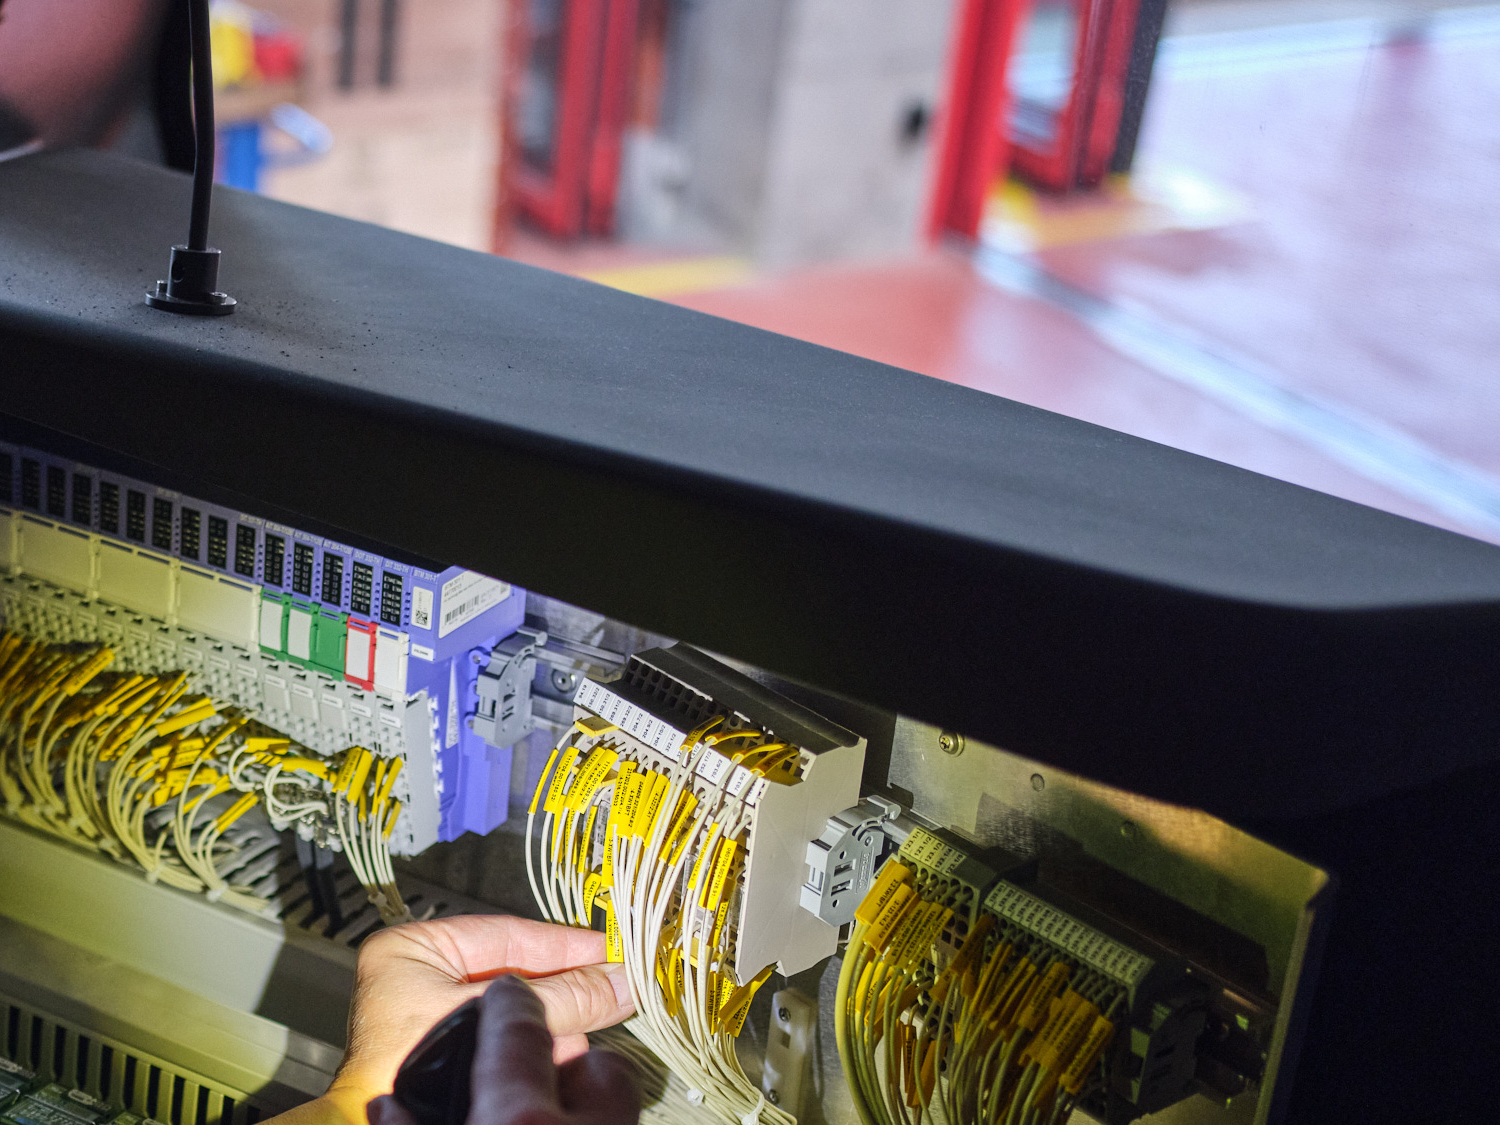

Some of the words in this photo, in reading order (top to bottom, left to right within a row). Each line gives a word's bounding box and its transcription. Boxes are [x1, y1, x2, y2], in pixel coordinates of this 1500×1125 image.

[632, 713, 643, 732] 204.7/2
[666, 733, 676, 752] 322.1/2
[699, 751, 712, 773] 252.17/2
[903, 831, 922, 851] 123.1/1
[914, 837, 932, 856] 123.1/2
[925, 843, 943, 862] 123.1/3
[935, 848, 953, 868] 123.1/4
